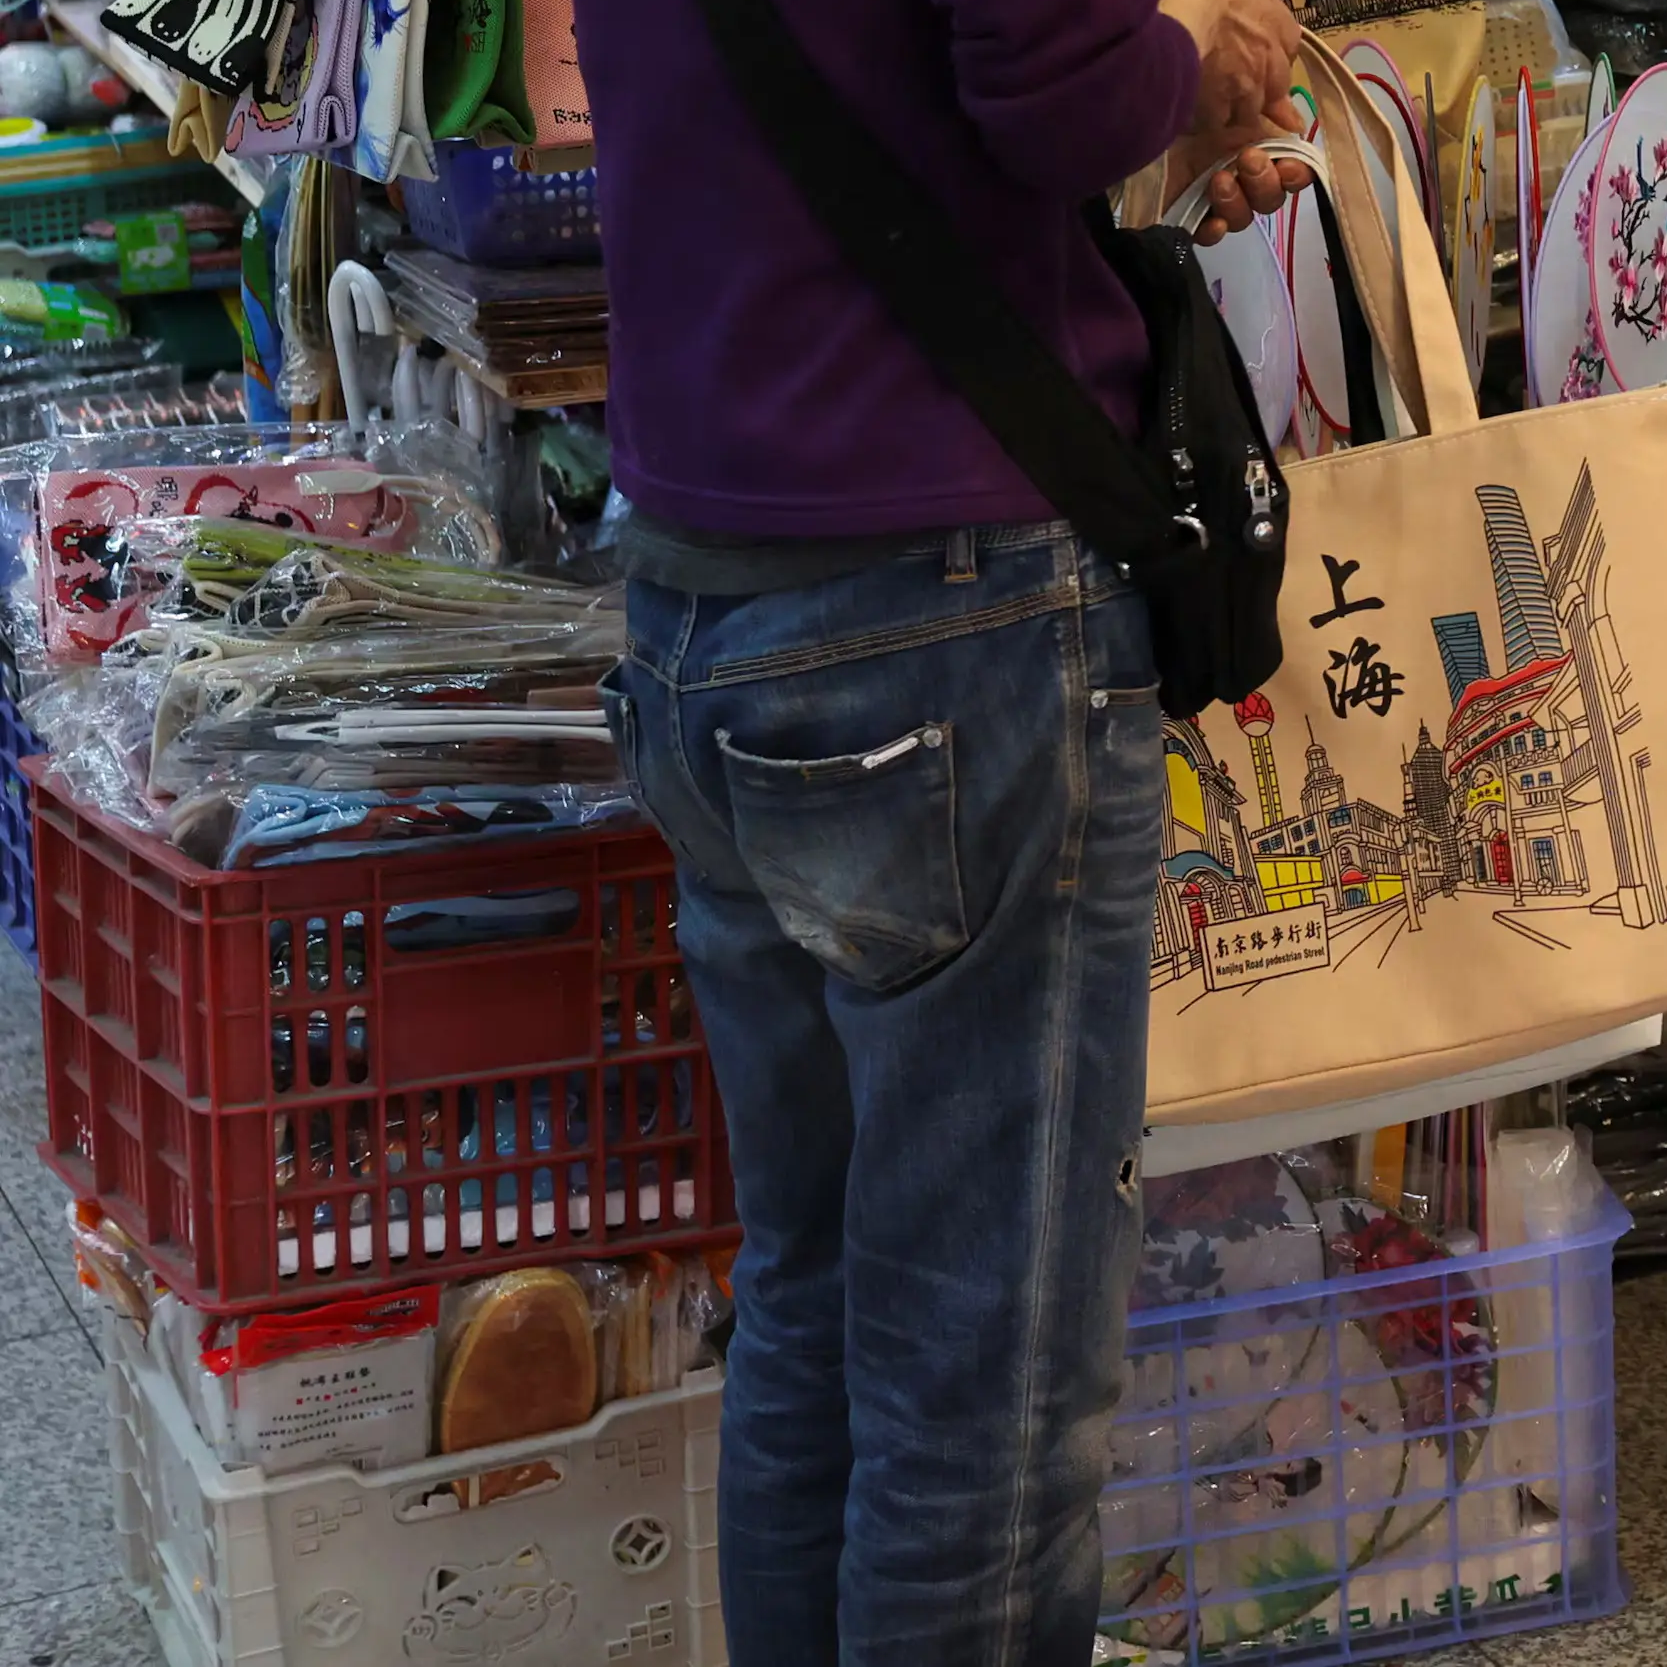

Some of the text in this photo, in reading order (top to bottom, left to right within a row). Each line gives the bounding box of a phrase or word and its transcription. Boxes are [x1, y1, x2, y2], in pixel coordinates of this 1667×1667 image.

[1308, 553, 1406, 720] 上海
[1214, 920, 1322, 959] 南京路步行街
[1216, 946, 1325, 976] Nanjing Road pedestrian Street
